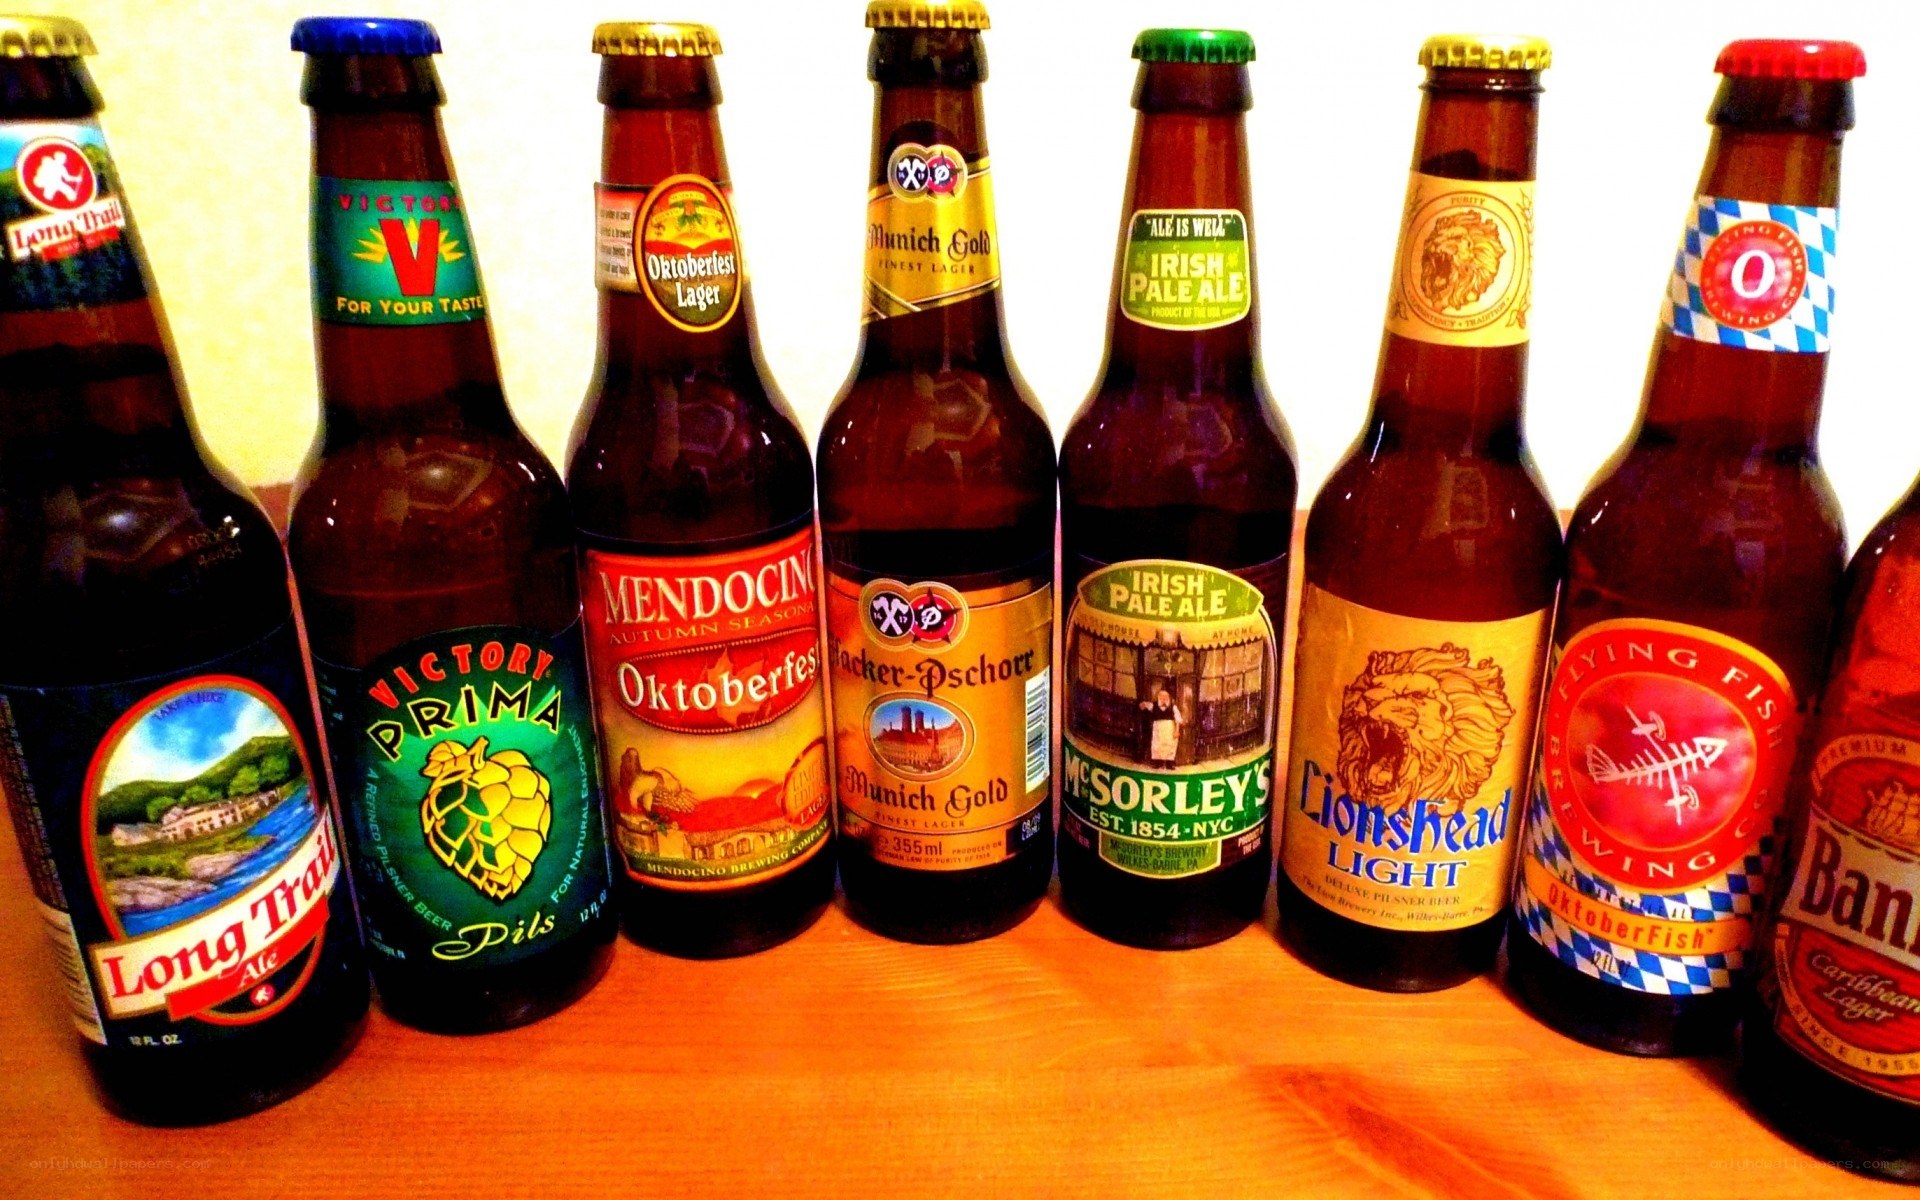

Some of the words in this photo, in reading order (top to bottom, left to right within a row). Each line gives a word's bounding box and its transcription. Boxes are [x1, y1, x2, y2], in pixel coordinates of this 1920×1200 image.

[1450, 195, 1486, 206] PURITY
[14, 219, 75, 250] Long
[77, 199, 122, 231] Trail
[1176, 217, 1189, 238] IS
[868, 222, 940, 253] Munich
[947, 227, 991, 262] Gold
[1777, 231, 1804, 271] FISH
[647, 250, 736, 281] Oktoberfest
[878, 259, 922, 272] FINEST
[932, 262, 975, 275] LAGER
[1150, 252, 1225, 279] IRISH
[1730, 249, 1776, 299] O
[675, 281, 721, 312] Lager
[1128, 271, 1193, 303] PALE
[1197, 271, 1245, 303] ALE
[336, 296, 372, 314] FOR
[379, 298, 434, 315] YOUR
[439, 295, 483, 313] TASTE
[1151, 305, 1182, 318] PRODUCT
[1132, 569, 1205, 597] IRISH
[1109, 583, 1174, 618] PALE
[1176, 588, 1228, 618] ALE
[608, 621, 719, 646] AUTUMN
[1108, 623, 1140, 638] HOUSE
[367, 641, 554, 709] VICTORY
[1558, 641, 1699, 702] FLYING
[1720, 665, 1784, 750] FISH
[366, 681, 561, 762] PRIMA
[845, 765, 936, 812] Munich
[944, 777, 1009, 819] Gold
[1301, 759, 1512, 854] Lionshead
[1550, 734, 1717, 879] BREWING
[874, 810, 917, 828] FINEST
[924, 818, 965, 829] LAGER
[1089, 806, 1126, 833] EST.
[1130, 819, 1181, 840] 1854
[1192, 815, 1235, 838] NYC
[365, 785, 381, 842] REFINED
[376, 844, 415, 904] PILSNER
[413, 899, 454, 932] BEER
[551, 872, 574, 905] FOR
[568, 803, 590, 871] NATURAL
[647, 862, 727, 877] MENDOCINO
[730, 851, 789, 874] BREWING
[791, 817, 829, 856] COMPANY
[935, 857, 961, 865] PURITY
[951, 843, 991, 855] PRODUCED
[1165, 845, 1208, 858] BREWERY
[1186, 858, 1199, 870] PA
[1327, 840, 1467, 888] LIGHT
[1316, 885, 1336, 902] Lion
[1337, 896, 1376, 916] Brewery
[1324, 874, 1370, 900] DELUXE
[1373, 892, 1426, 906] PILSNER
[1430, 895, 1461, 906] BEER
[102, 920, 248, 1000] Long
[249, 825, 337, 940] Trail
[431, 910, 556, 961] Pils
[236, 948, 279, 989] Ale
[1822, 985, 1895, 1022] Lager
